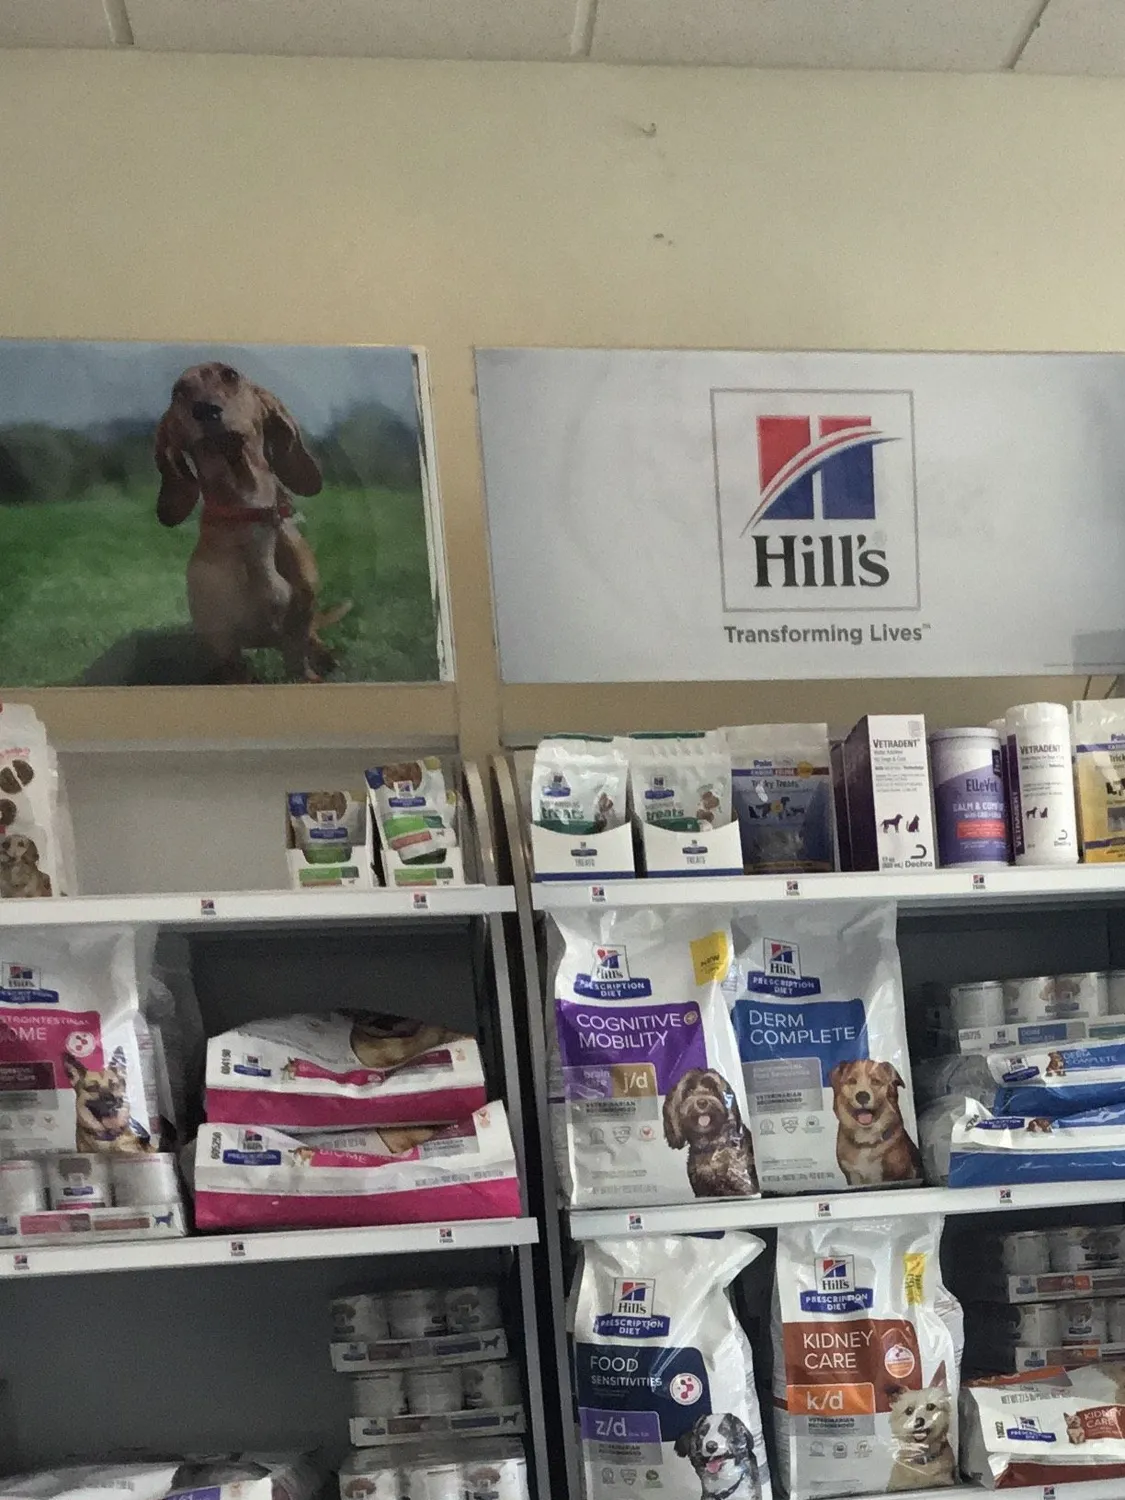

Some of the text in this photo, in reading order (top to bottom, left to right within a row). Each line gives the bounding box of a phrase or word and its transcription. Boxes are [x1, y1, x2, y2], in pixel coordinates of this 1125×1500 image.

[753, 533, 890, 588] Hill's
[724, 625, 863, 645] Transforming
[646, 807, 684, 820] treats
[905, 860, 932, 868] Dechra
[601, 989, 622, 998] DIET
[577, 1013, 682, 1031] COGNITIVE
[750, 1011, 804, 1027] DERM
[579, 1030, 669, 1049] MOBILITY
[751, 1026, 855, 1046] COMPLETE
[624, 1070, 649, 1092] j/d
[821, 1278, 850, 1291] Hill's
[618, 1302, 647, 1315] Hill's
[826, 1303, 848, 1311] DIET
[619, 1327, 640, 1335] DIET
[803, 1329, 874, 1348] KIDNEY
[590, 1355, 638, 1373] FOOD
[805, 1352, 857, 1370] CARE
[591, 1375, 663, 1388] SENSITIVITIES
[806, 1391, 843, 1411] k/d
[595, 1417, 627, 1437] z/d
